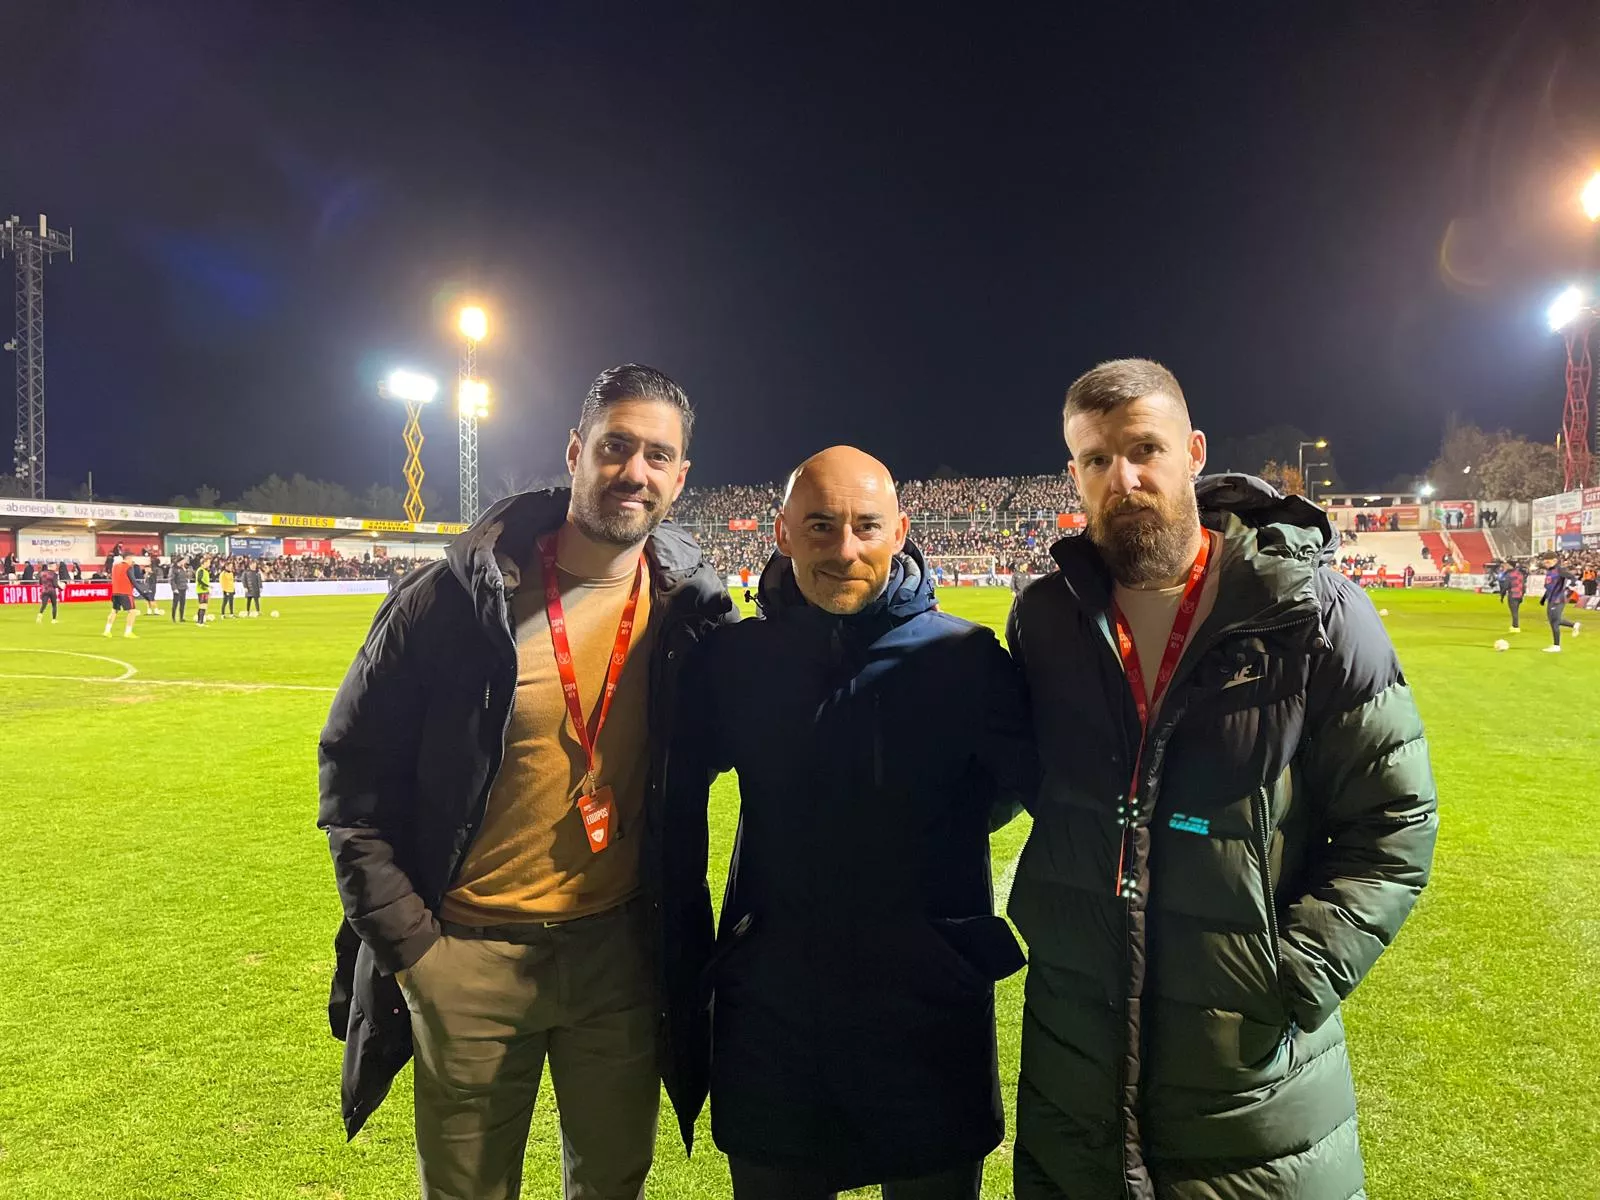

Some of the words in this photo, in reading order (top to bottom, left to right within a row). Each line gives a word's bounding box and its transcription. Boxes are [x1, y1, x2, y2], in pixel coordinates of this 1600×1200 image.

[279, 516, 328, 527] MUEBLES
[4, 586, 28, 603] COPA
[71, 588, 108, 597] MAPFRE
[586, 807, 609, 825] EQUIPOS
